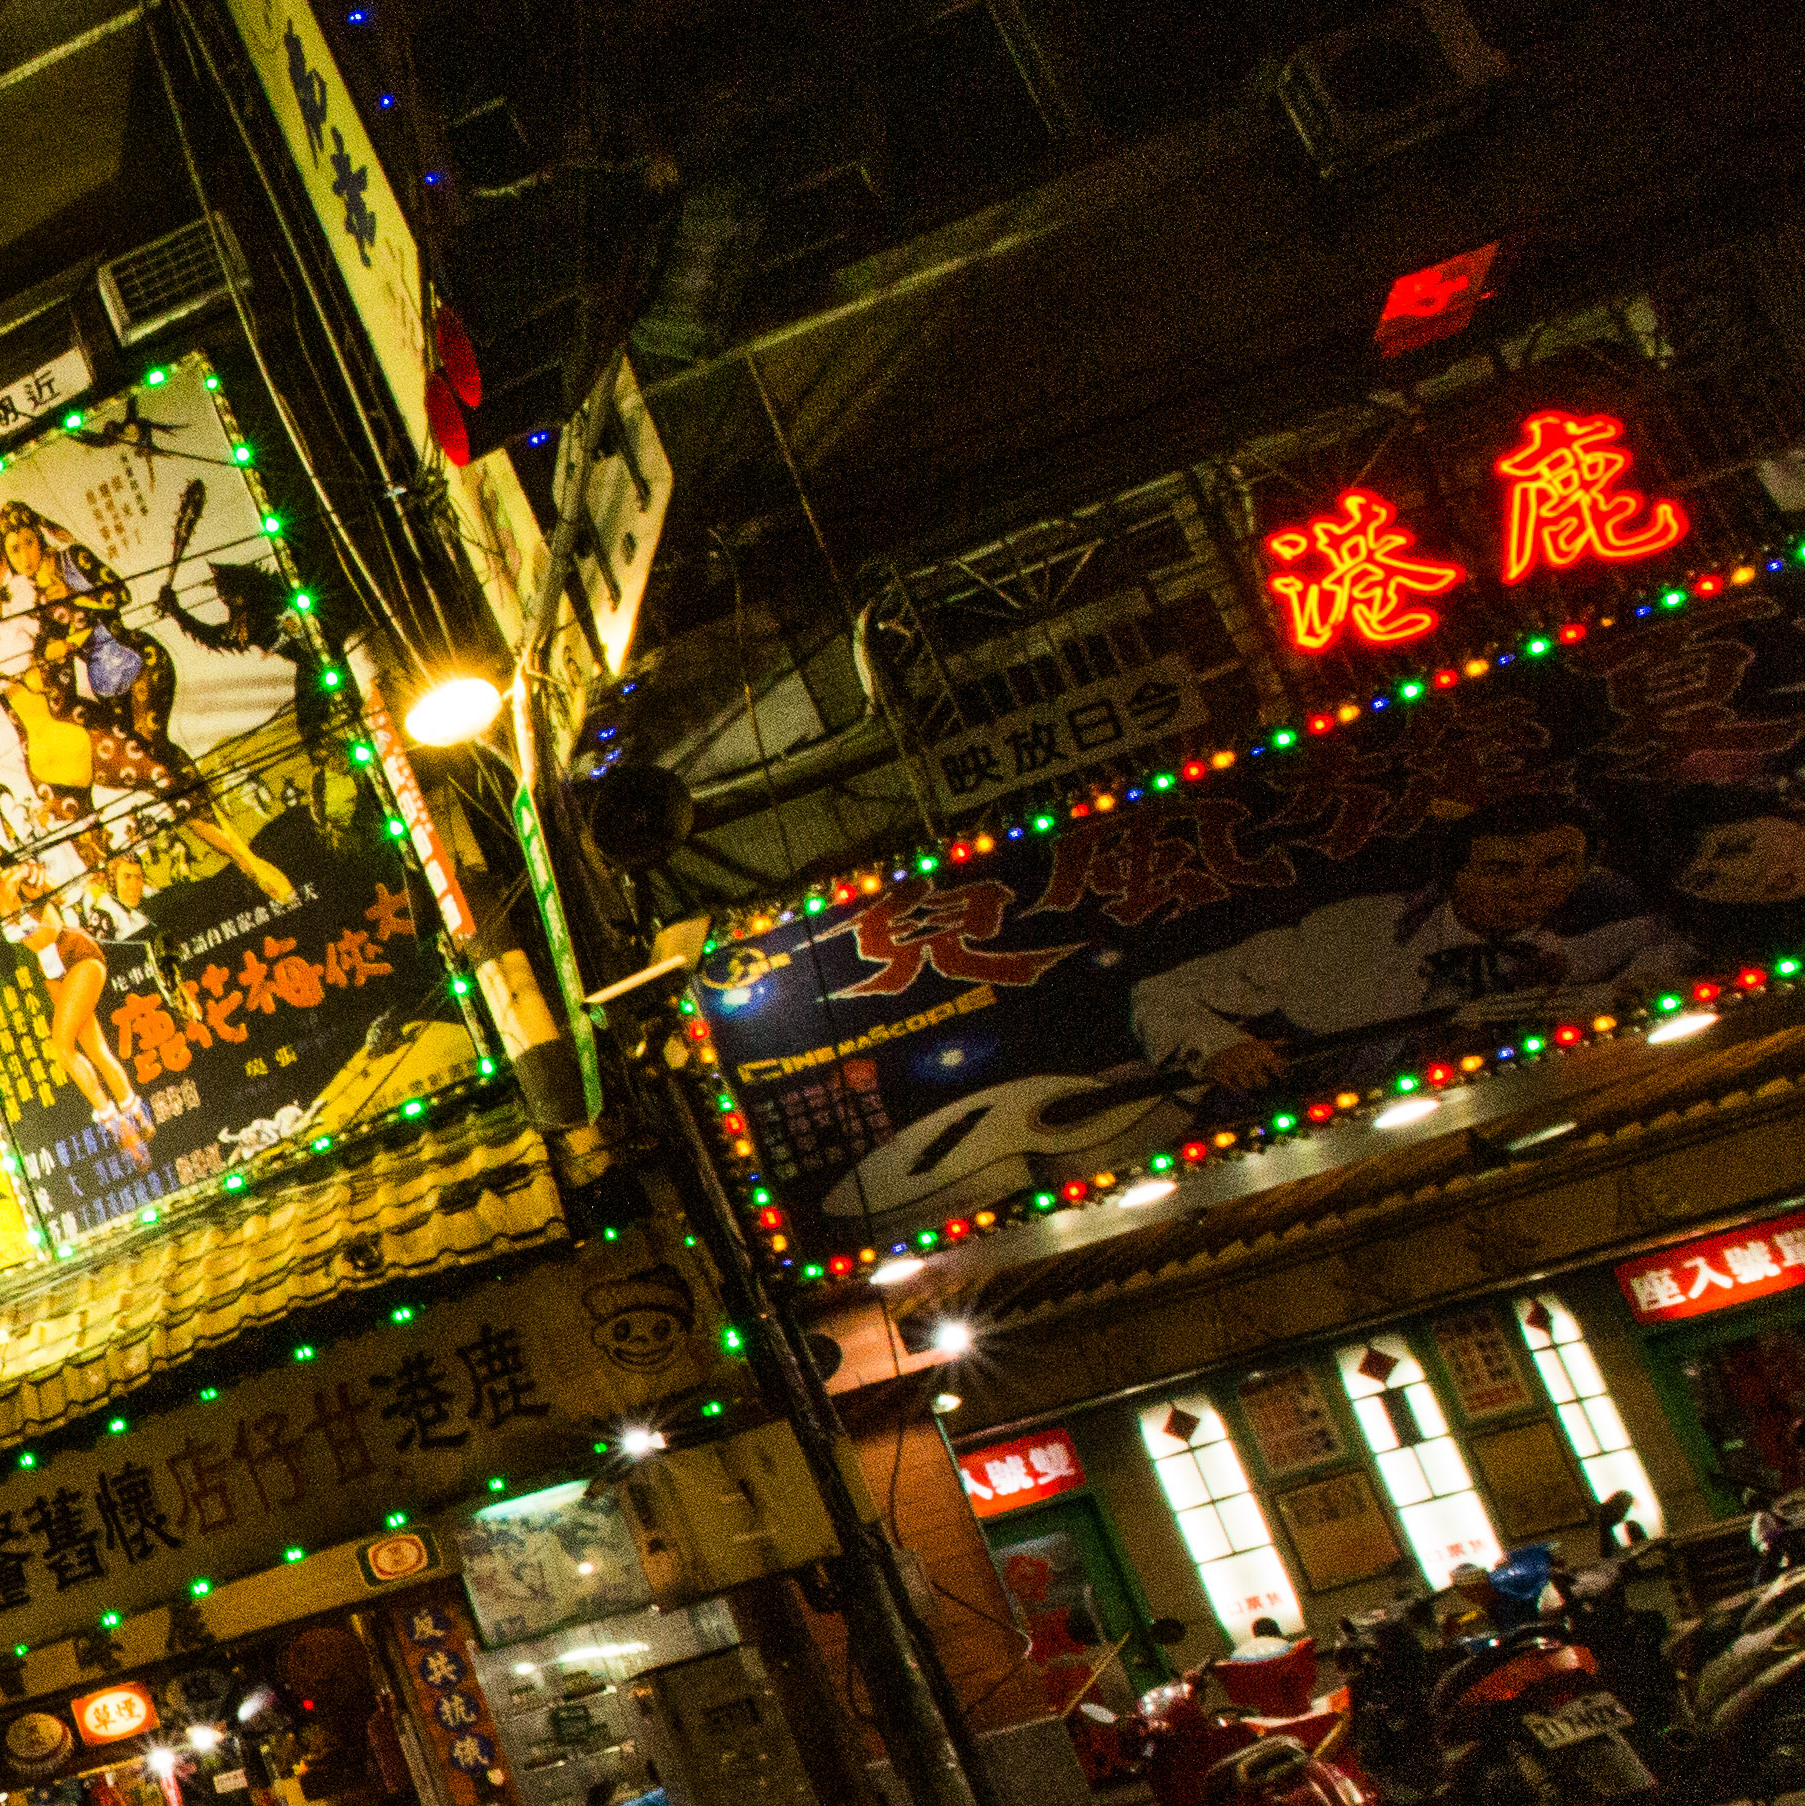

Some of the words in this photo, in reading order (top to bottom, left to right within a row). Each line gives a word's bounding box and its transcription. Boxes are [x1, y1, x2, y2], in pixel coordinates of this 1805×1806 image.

[1269, 410, 1686, 650] 鹿港
[939, 683, 1185, 796] 今日放映
